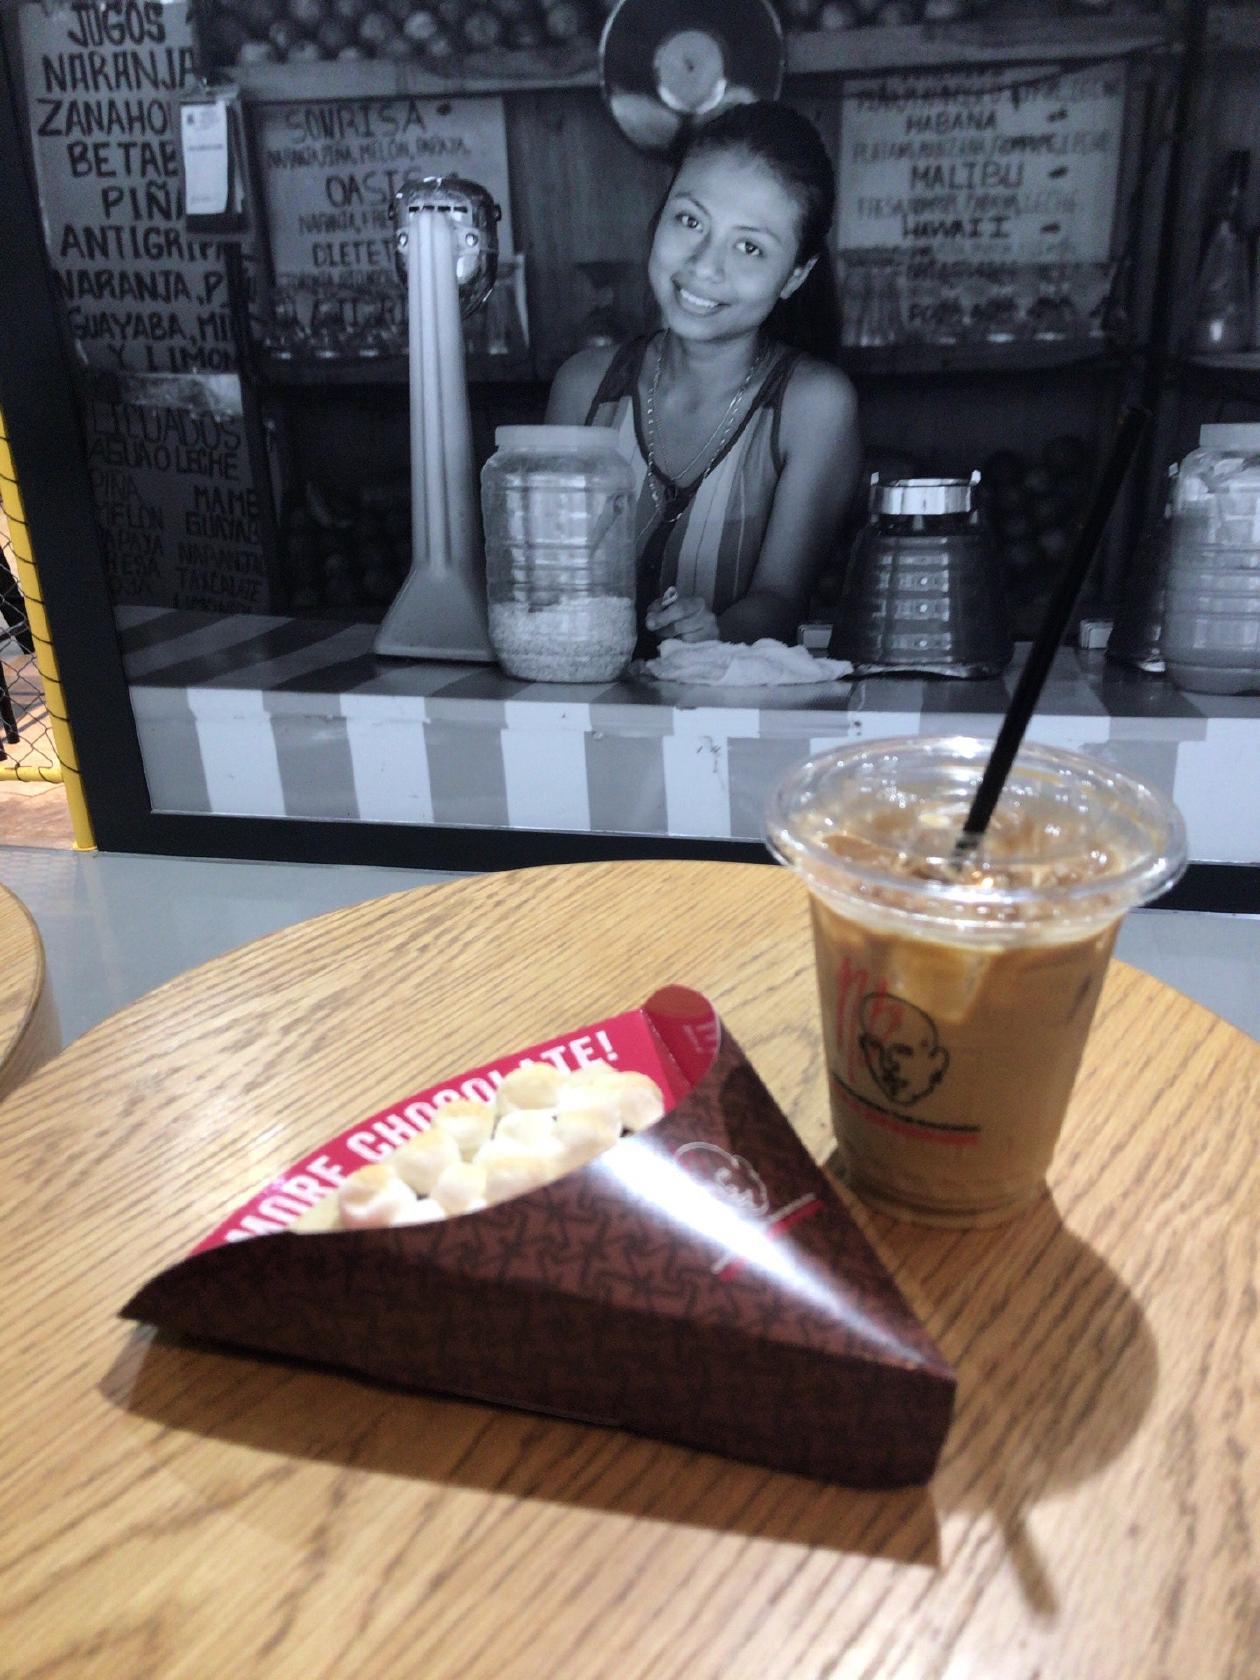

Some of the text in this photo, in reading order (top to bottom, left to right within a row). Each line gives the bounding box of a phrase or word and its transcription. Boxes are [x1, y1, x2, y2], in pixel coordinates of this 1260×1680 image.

[68, 2, 166, 48] JUGOS
[42, 47, 196, 93] NARANJA
[909, 160, 1025, 191] MALIBU
[224, 1154, 348, 1243] MORE
